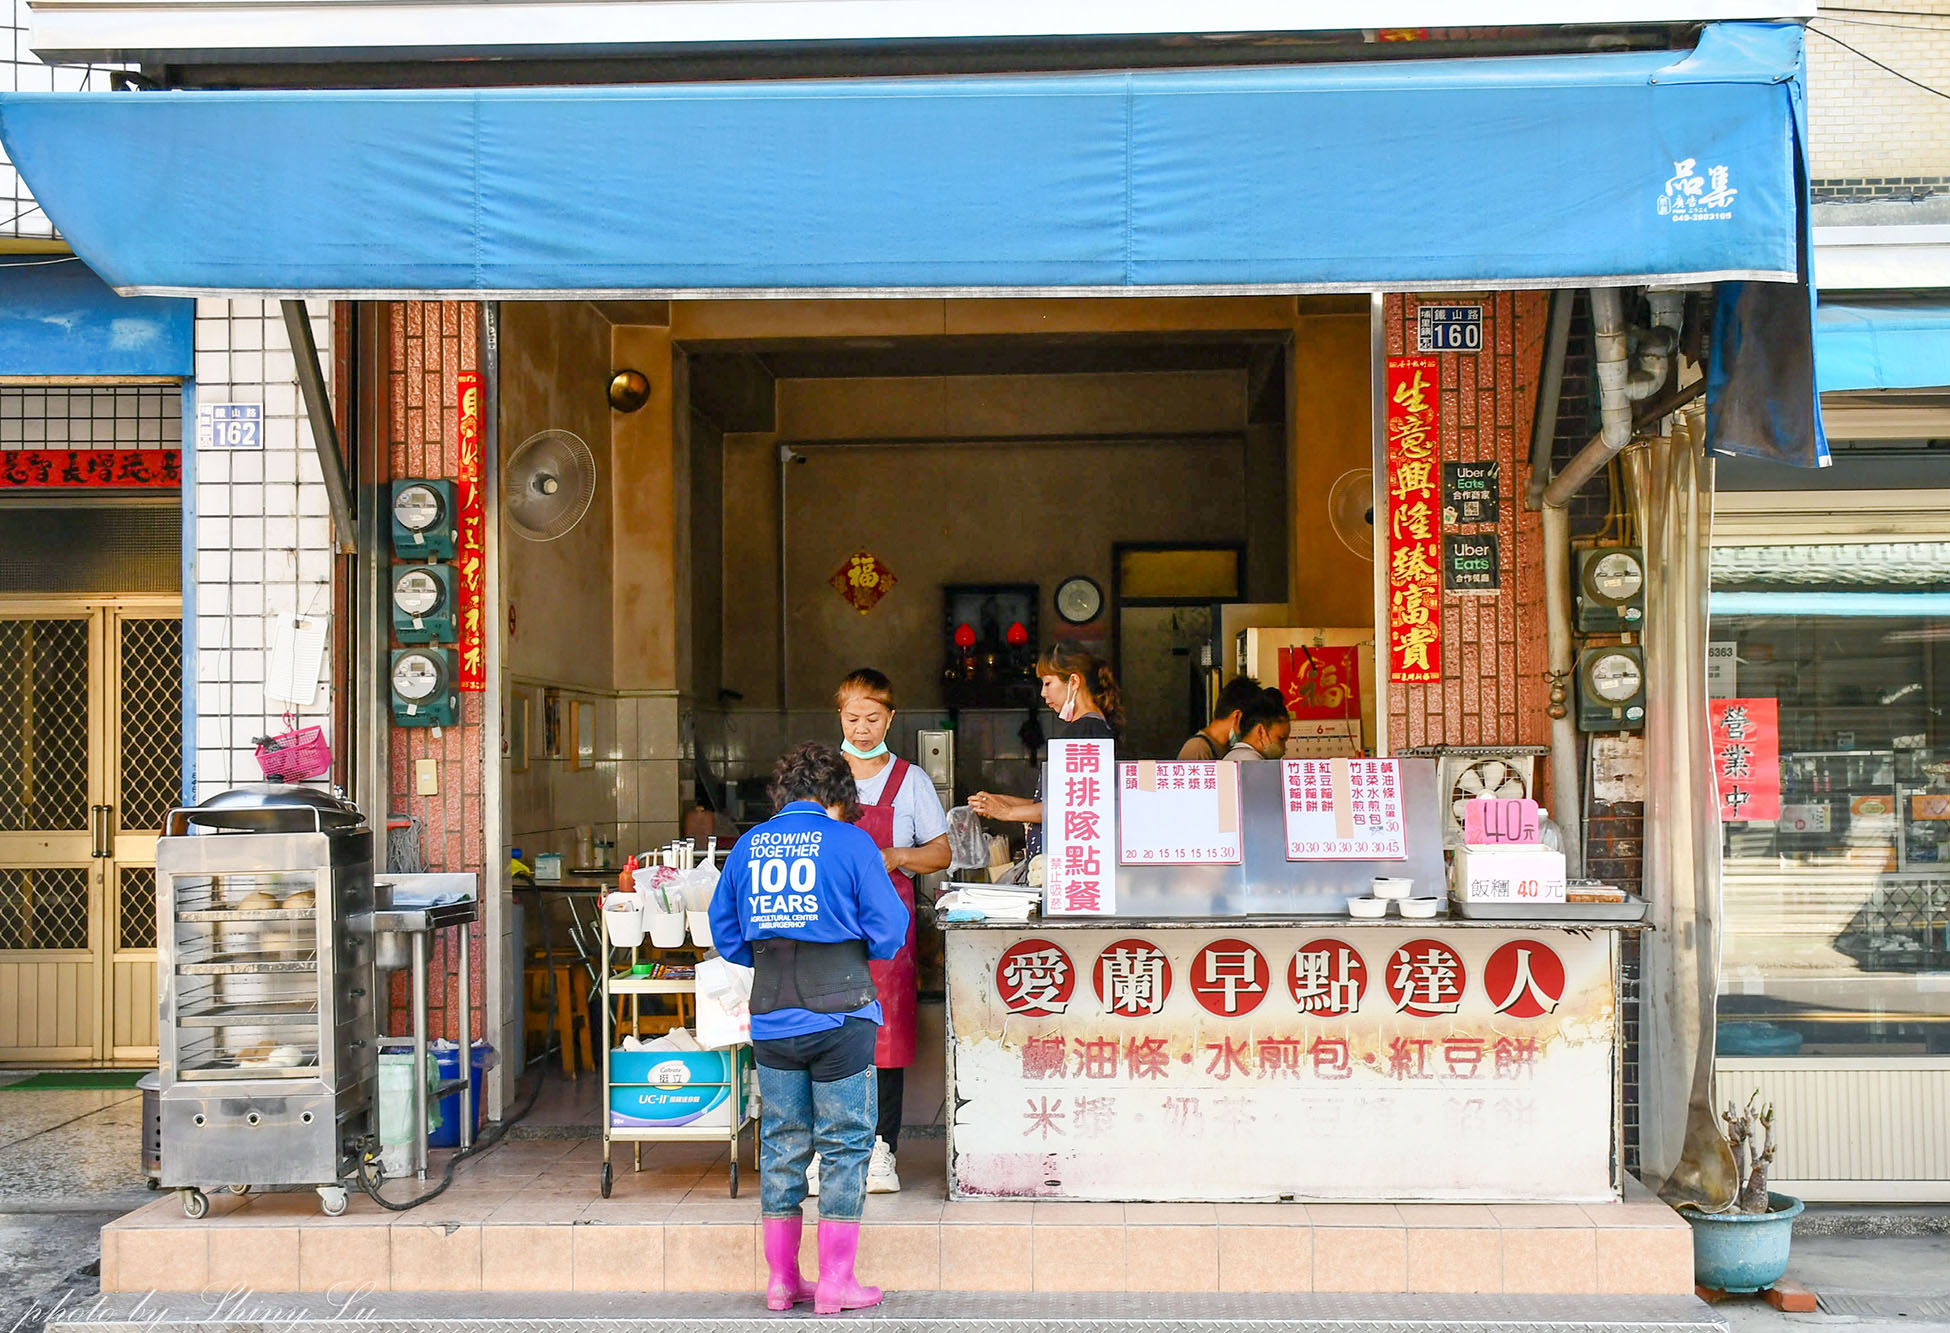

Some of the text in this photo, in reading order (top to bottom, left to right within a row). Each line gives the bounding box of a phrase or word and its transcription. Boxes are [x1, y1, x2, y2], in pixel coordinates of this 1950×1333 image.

[1434, 324, 1479, 347] 160
[216, 421, 256, 446] 162
[1457, 468, 1485, 478] Uber
[1457, 479, 1485, 489] Eats
[1390, 369, 1438, 671] 生意興隆臻富貴
[1454, 543, 1489, 556] Uber
[1454, 558, 1489, 570] Eats
[848, 556, 879, 588] 福
[1316, 724, 1324, 735] 6
[1719, 705, 1751, 818] 營業中
[1065, 743, 1101, 911] 請排隊點餐
[1385, 821, 1399, 832] 30
[751, 832, 822, 846] GROWING
[750, 844, 820, 858] TOGETHER
[1126, 847, 1235, 858] 20 20 15 15 15 15 30
[1292, 842, 1305, 853] 30
[1306, 842, 1319, 853] 30
[1323, 842, 1336, 853] 30
[1339, 842, 1352, 853] 30
[1355, 842, 1368, 853] 30
[1371, 842, 1384, 853] 30
[748, 858, 816, 894] 100
[1471, 879, 1563, 898] 飯糰 40 元
[748, 895, 818, 914] YEARS
[751, 914, 818, 923] AGRICULTURAL CENTER
[1003, 947, 1560, 1015] 愛蘭早點達人
